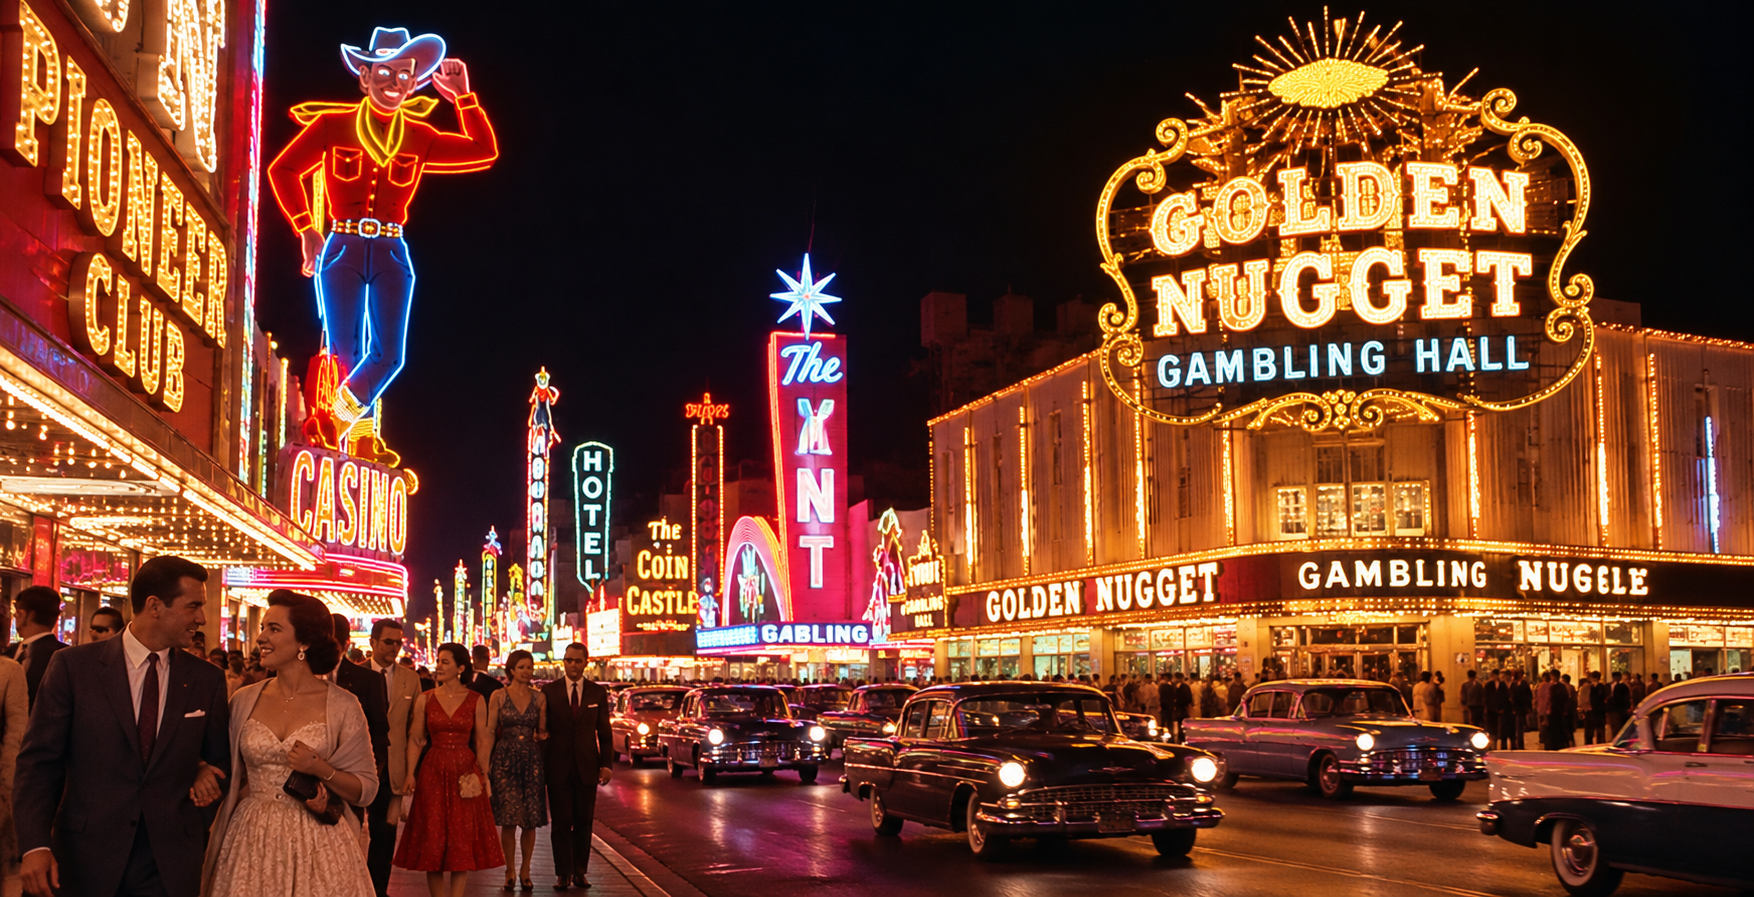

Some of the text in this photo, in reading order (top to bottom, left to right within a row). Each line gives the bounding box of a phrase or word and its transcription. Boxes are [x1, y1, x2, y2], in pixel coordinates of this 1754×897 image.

[15, 0, 227, 349] PIONEER
[1149, 161, 1530, 256] GOLDEN
[85, 252, 185, 413] CLUB
[1152, 246, 1533, 337] NUGGET
[780, 341, 844, 386] The
[1157, 335, 1530, 389] GAMBLING HALL
[290, 450, 407, 555] CASINO
[582, 450, 603, 581] HOTEL
[647, 518, 682, 540] The
[985, 560, 1220, 623] GOLDEN NUGGET
[1298, 558, 1487, 590] GAMBLING
